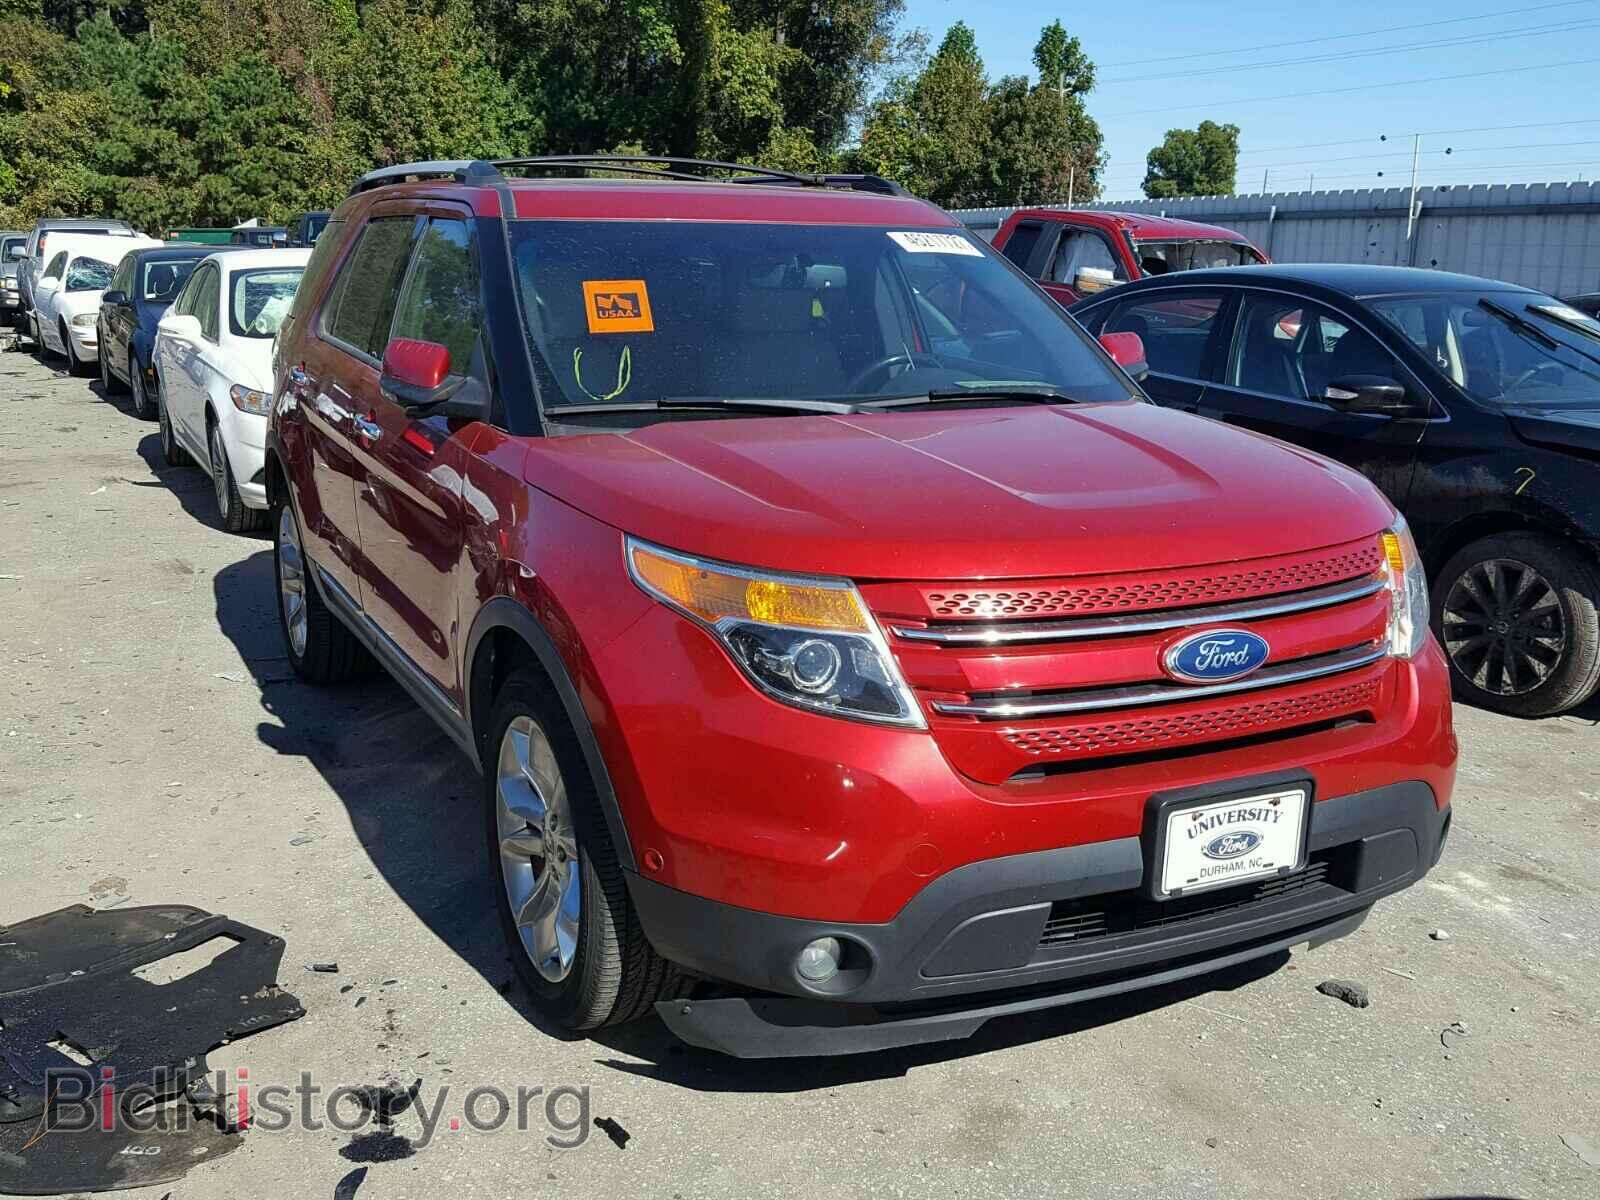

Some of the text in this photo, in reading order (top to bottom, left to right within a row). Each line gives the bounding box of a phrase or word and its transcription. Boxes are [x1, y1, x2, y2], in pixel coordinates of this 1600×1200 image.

[599, 310, 635, 318] USAA
[1195, 639, 1249, 671] Ford
[1186, 807, 1284, 840] UNIVERSITY
[1218, 834, 1249, 855] Ford
[1200, 857, 1263, 878] DURHAM, NC
